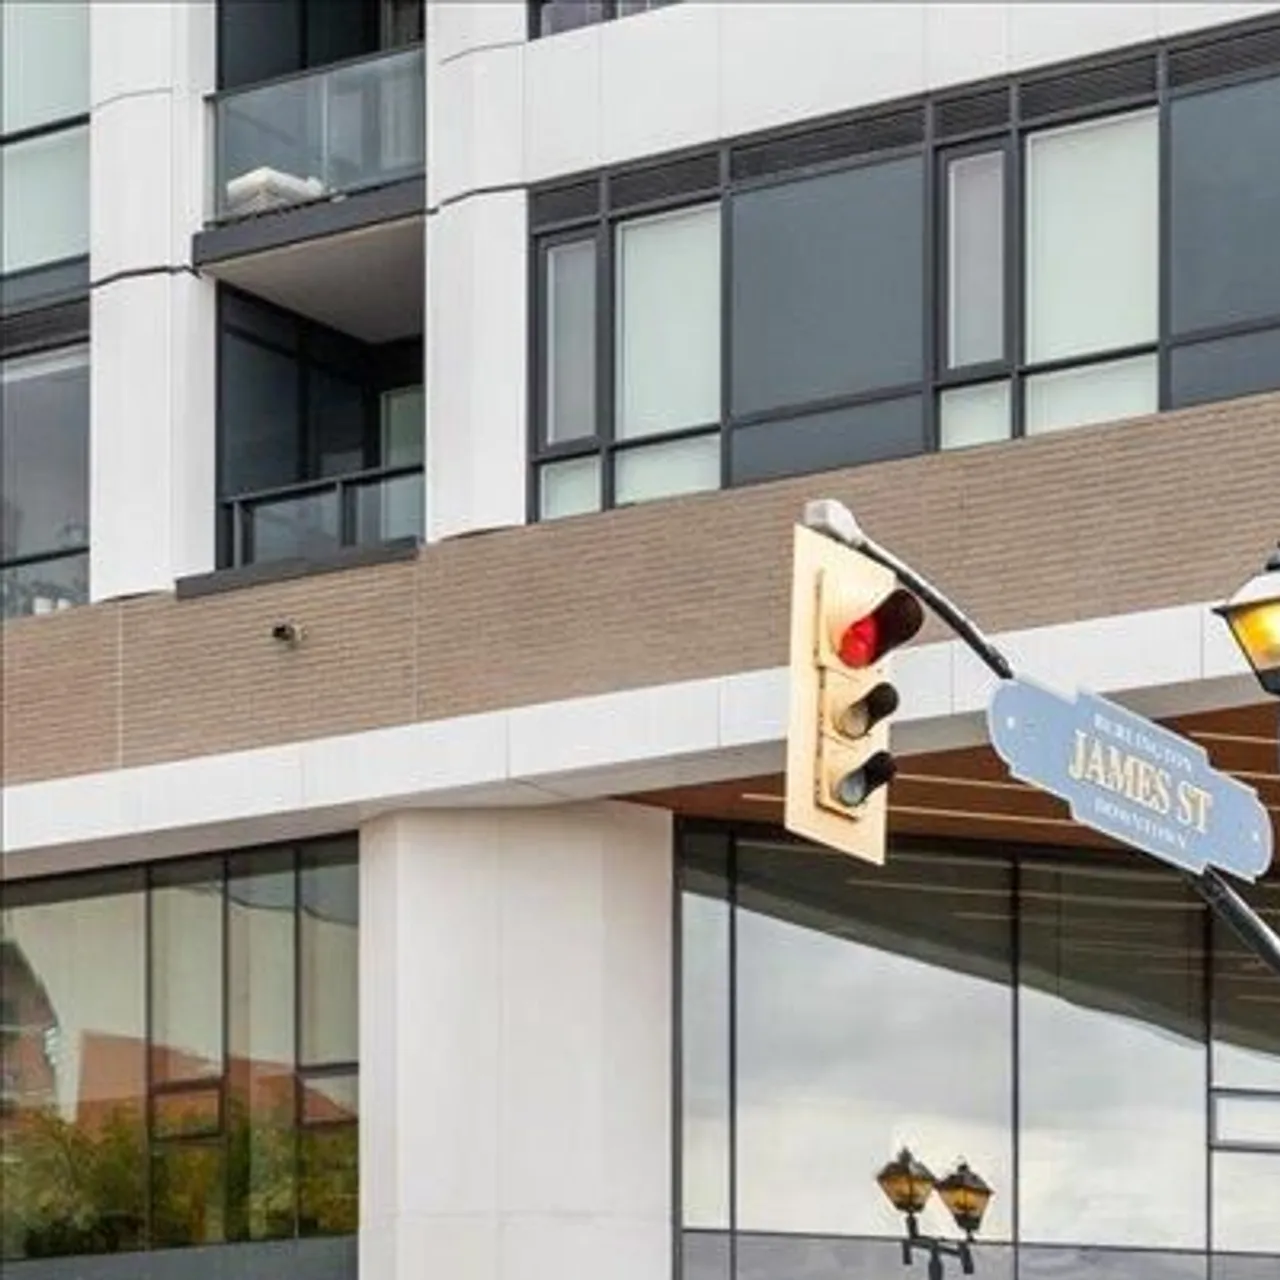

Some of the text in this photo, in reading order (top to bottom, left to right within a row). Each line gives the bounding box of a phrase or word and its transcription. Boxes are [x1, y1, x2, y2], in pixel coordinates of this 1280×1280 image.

[1094, 713, 1192, 773] BURLINGTON
[1068, 729, 1213, 834] JAMES ST
[1094, 797, 1189, 849] DOWNTOWN
